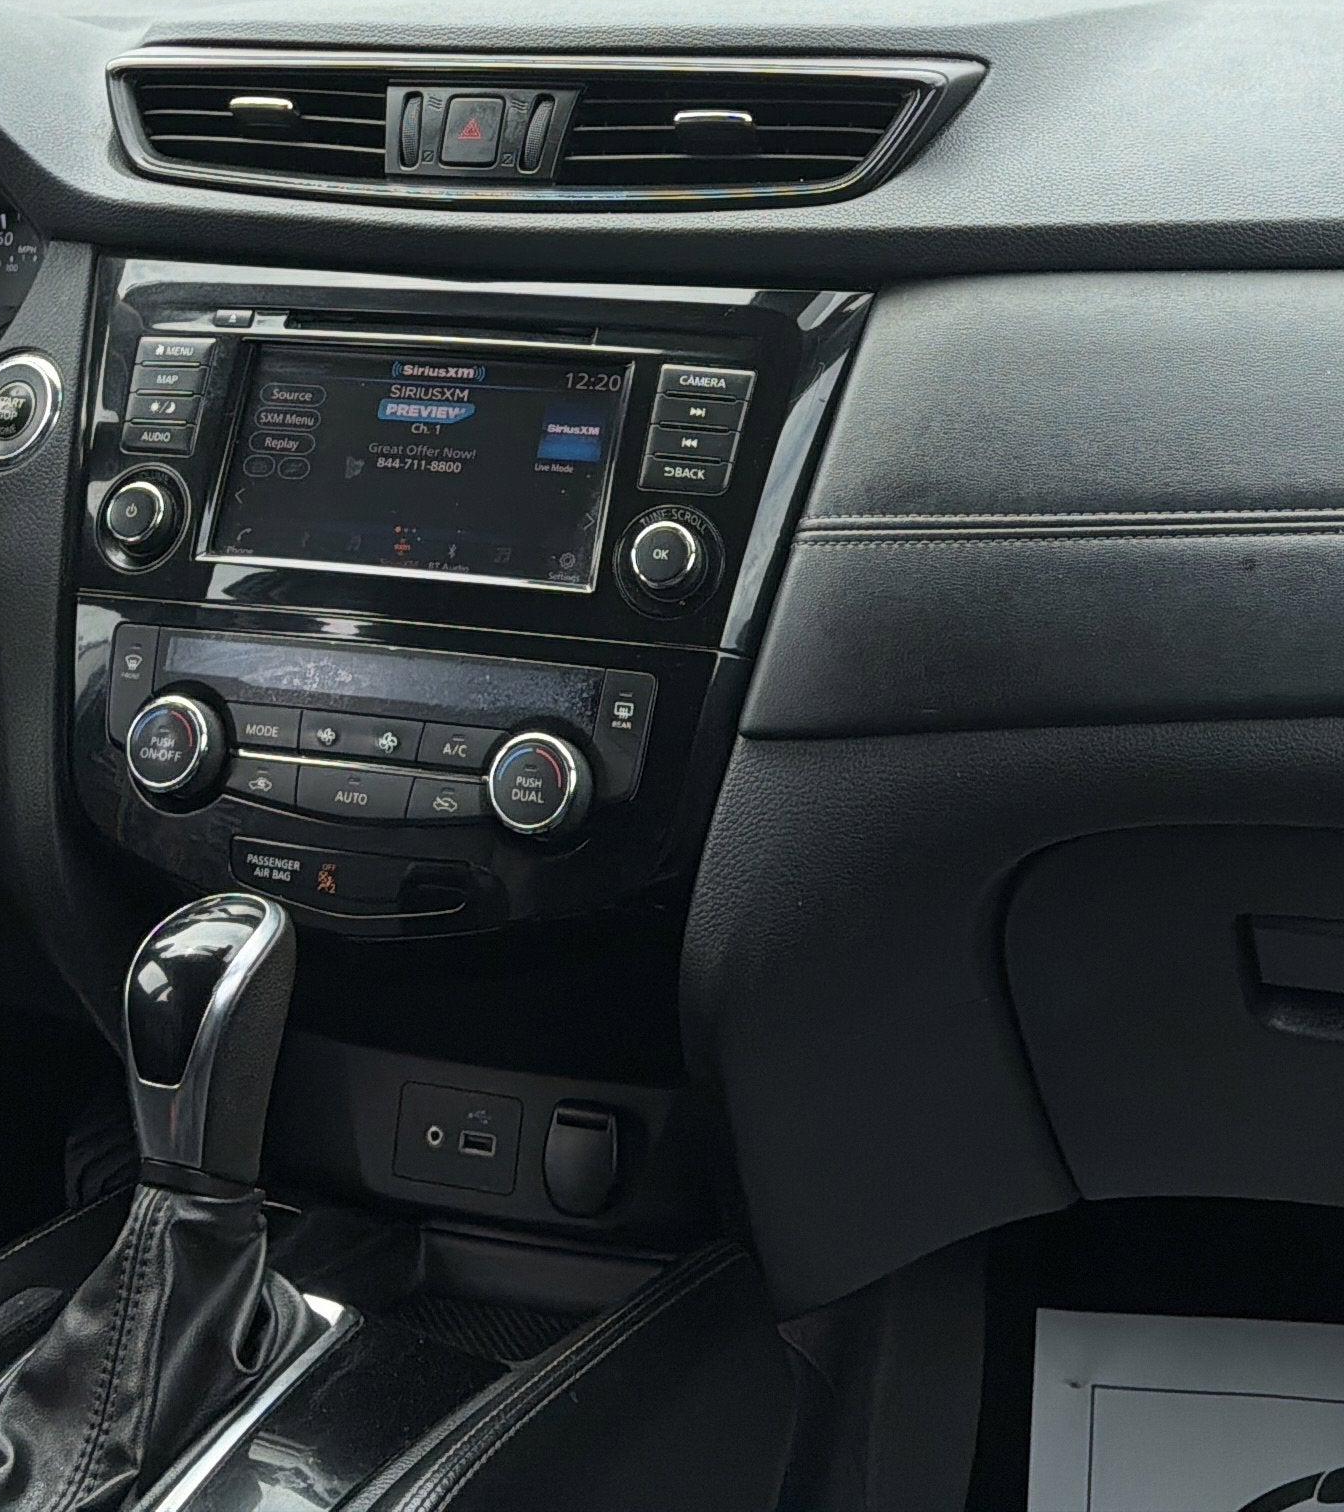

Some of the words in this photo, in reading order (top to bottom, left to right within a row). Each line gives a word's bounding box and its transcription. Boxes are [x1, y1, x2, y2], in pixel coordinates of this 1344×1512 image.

[166, 346, 194, 357] MENU
[157, 374, 179, 385] MAP
[565, 372, 622, 392] 12:20
[679, 375, 726, 388] CAMERA
[271, 389, 313, 402] Source
[390, 385, 469, 401] SIRIUSXM
[260, 413, 284, 425] SXM
[285, 414, 315, 426] Menu
[141, 431, 171, 442] AUDIO
[264, 437, 300, 452] Replay
[369, 442, 403, 455] Great
[407, 444, 441, 457] Offer
[443, 446, 477, 459] Now!
[376, 457, 462, 473] 844-711-8800
[675, 467, 705, 480] BACK
[653, 549, 669, 560] OK
[246, 724, 280, 737] MODE
[150, 736, 175, 748] PUSH
[442, 743, 467, 758] A/C
[516, 776, 542, 788] PUSH
[334, 791, 367, 805] AUTO
[511, 789, 544, 804] DUAL
[246, 853, 301, 871] PASSENGER
[254, 868, 270, 879] AIR
[272, 870, 291, 882] BAG
